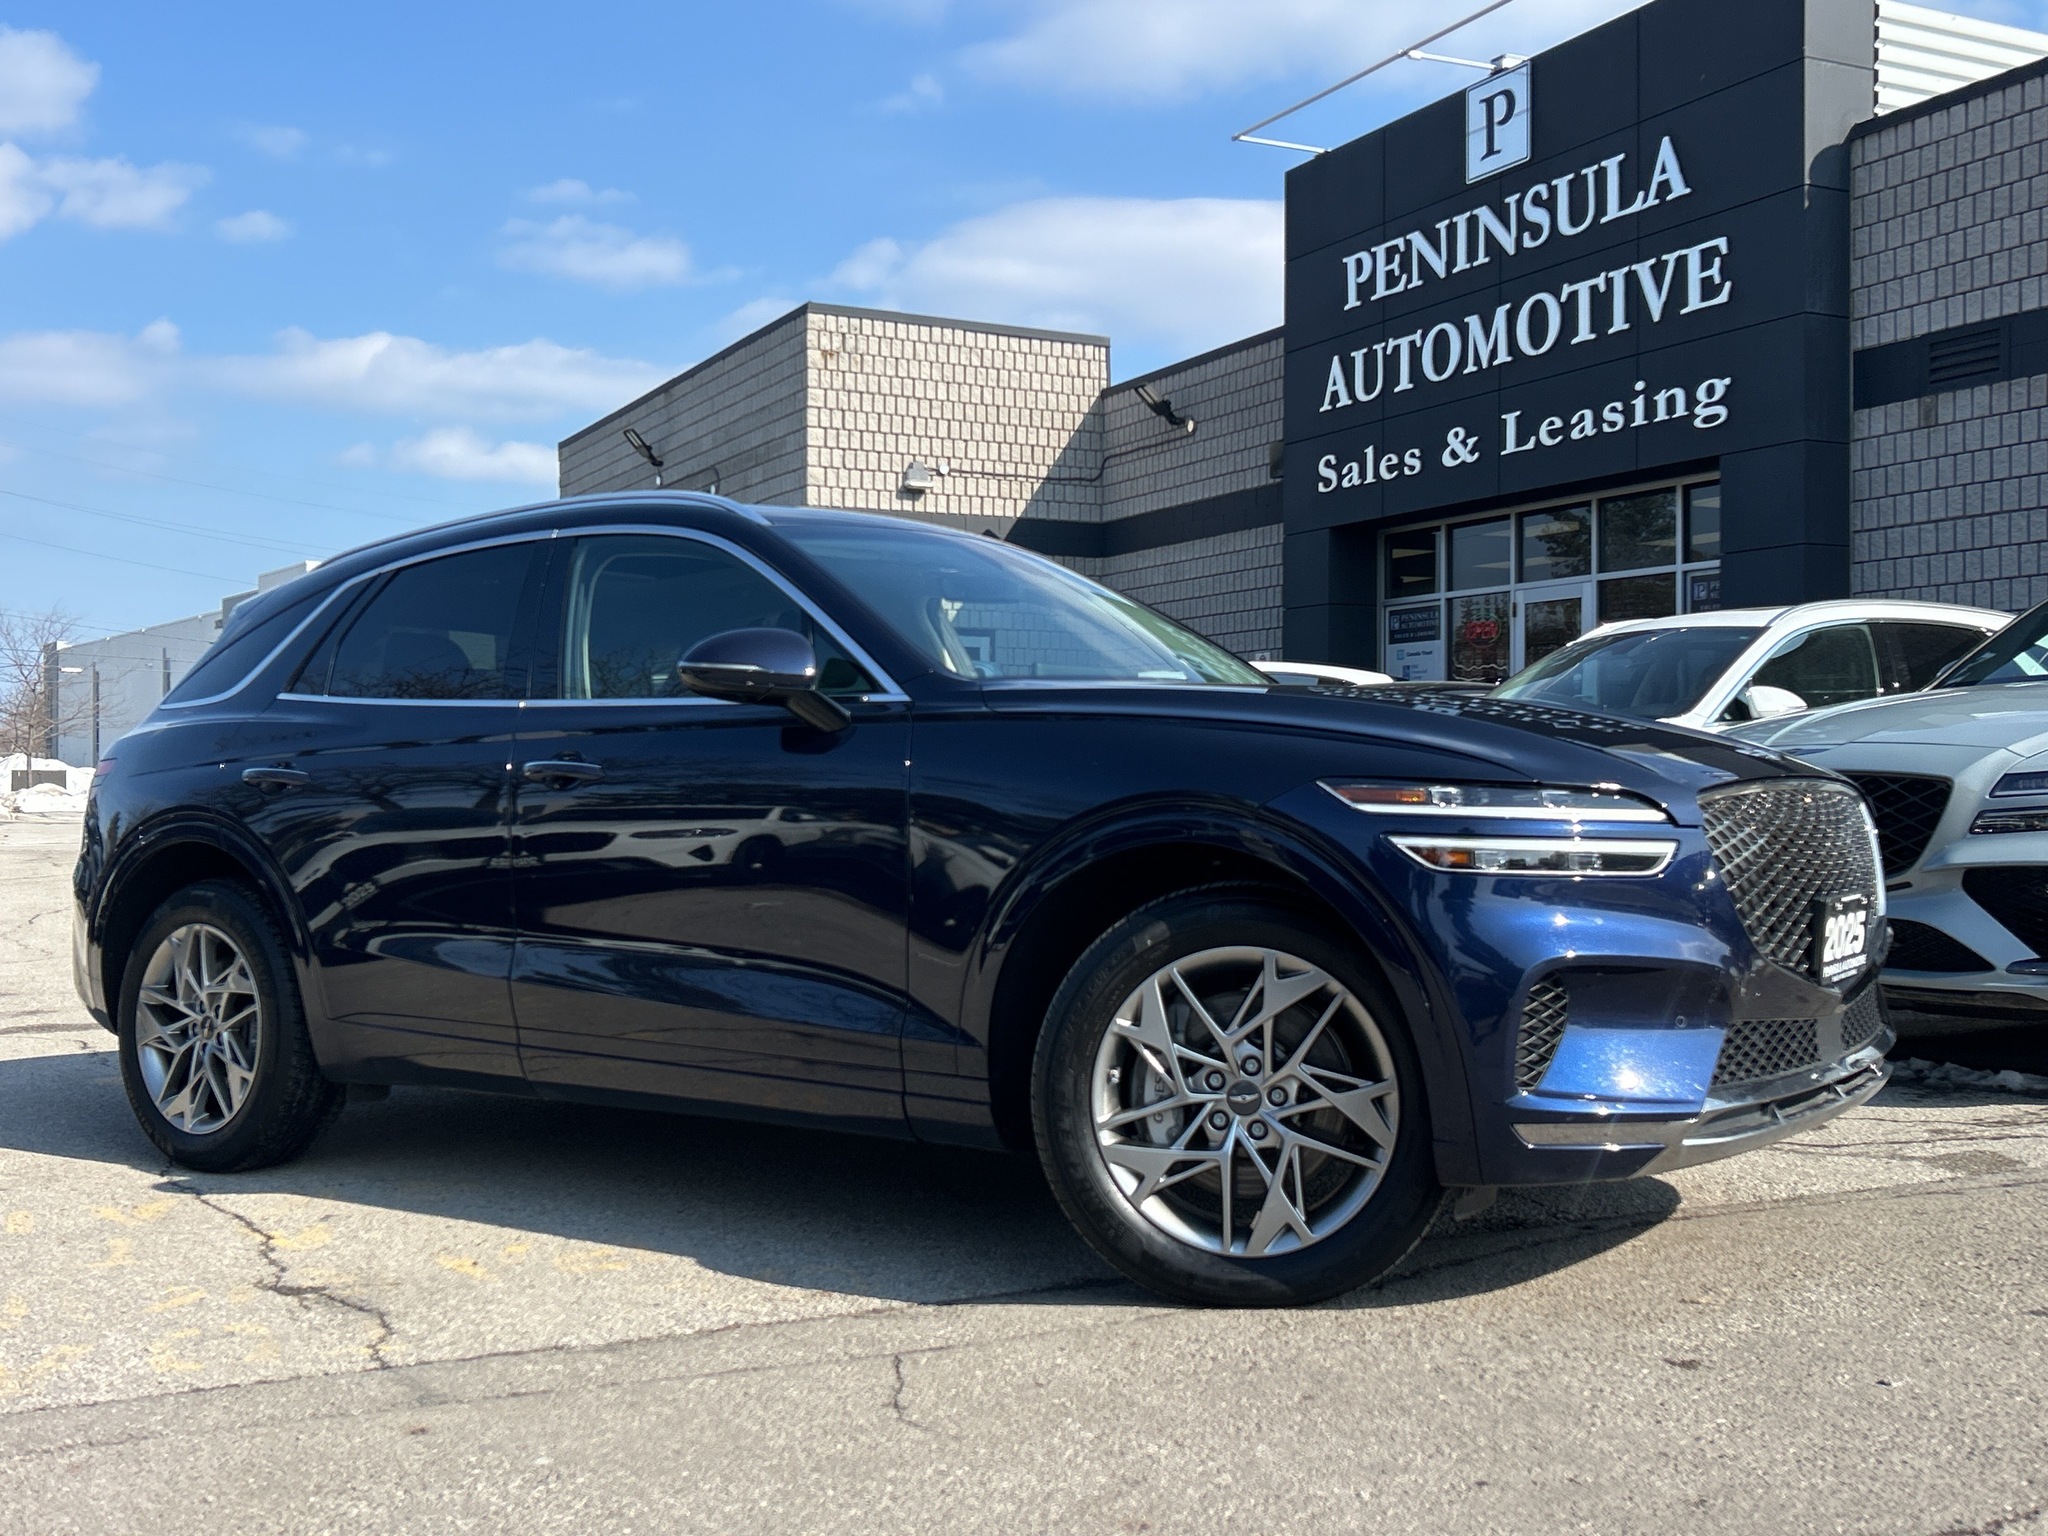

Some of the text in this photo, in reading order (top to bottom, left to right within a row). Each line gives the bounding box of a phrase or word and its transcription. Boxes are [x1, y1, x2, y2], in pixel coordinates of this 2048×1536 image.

[1478, 88, 1517, 161] P
[1342, 135, 1693, 311] PENINSULA
[1318, 236, 1733, 413] AUTOMOTIVE
[1317, 376, 1732, 493] Sales & Leasing
[1823, 911, 1867, 962] 2025
